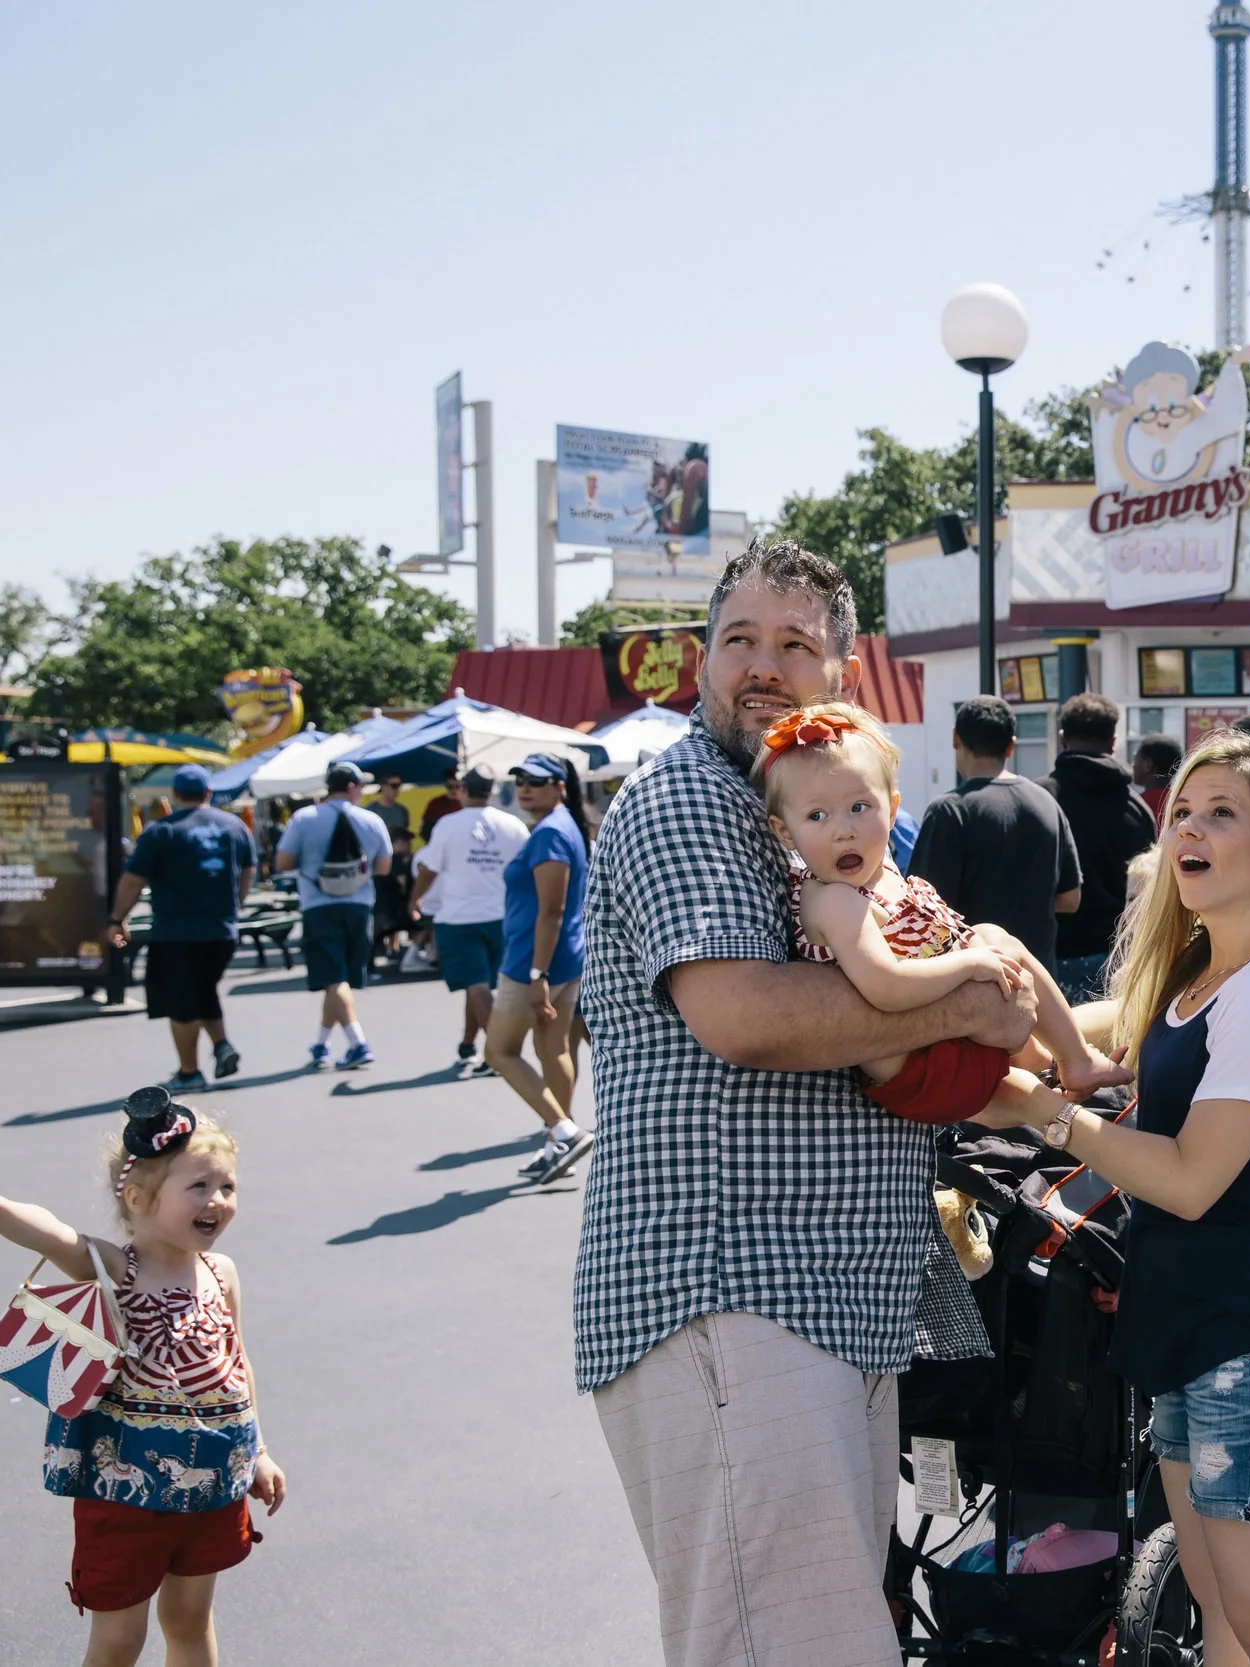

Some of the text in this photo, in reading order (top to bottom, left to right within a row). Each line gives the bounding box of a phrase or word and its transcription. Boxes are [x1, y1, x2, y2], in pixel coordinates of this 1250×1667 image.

[1089, 466, 1247, 534] Granny's
[1111, 537, 1223, 574] GRILL
[643, 640, 685, 668] Jelly
[633, 663, 680, 704] Belly
